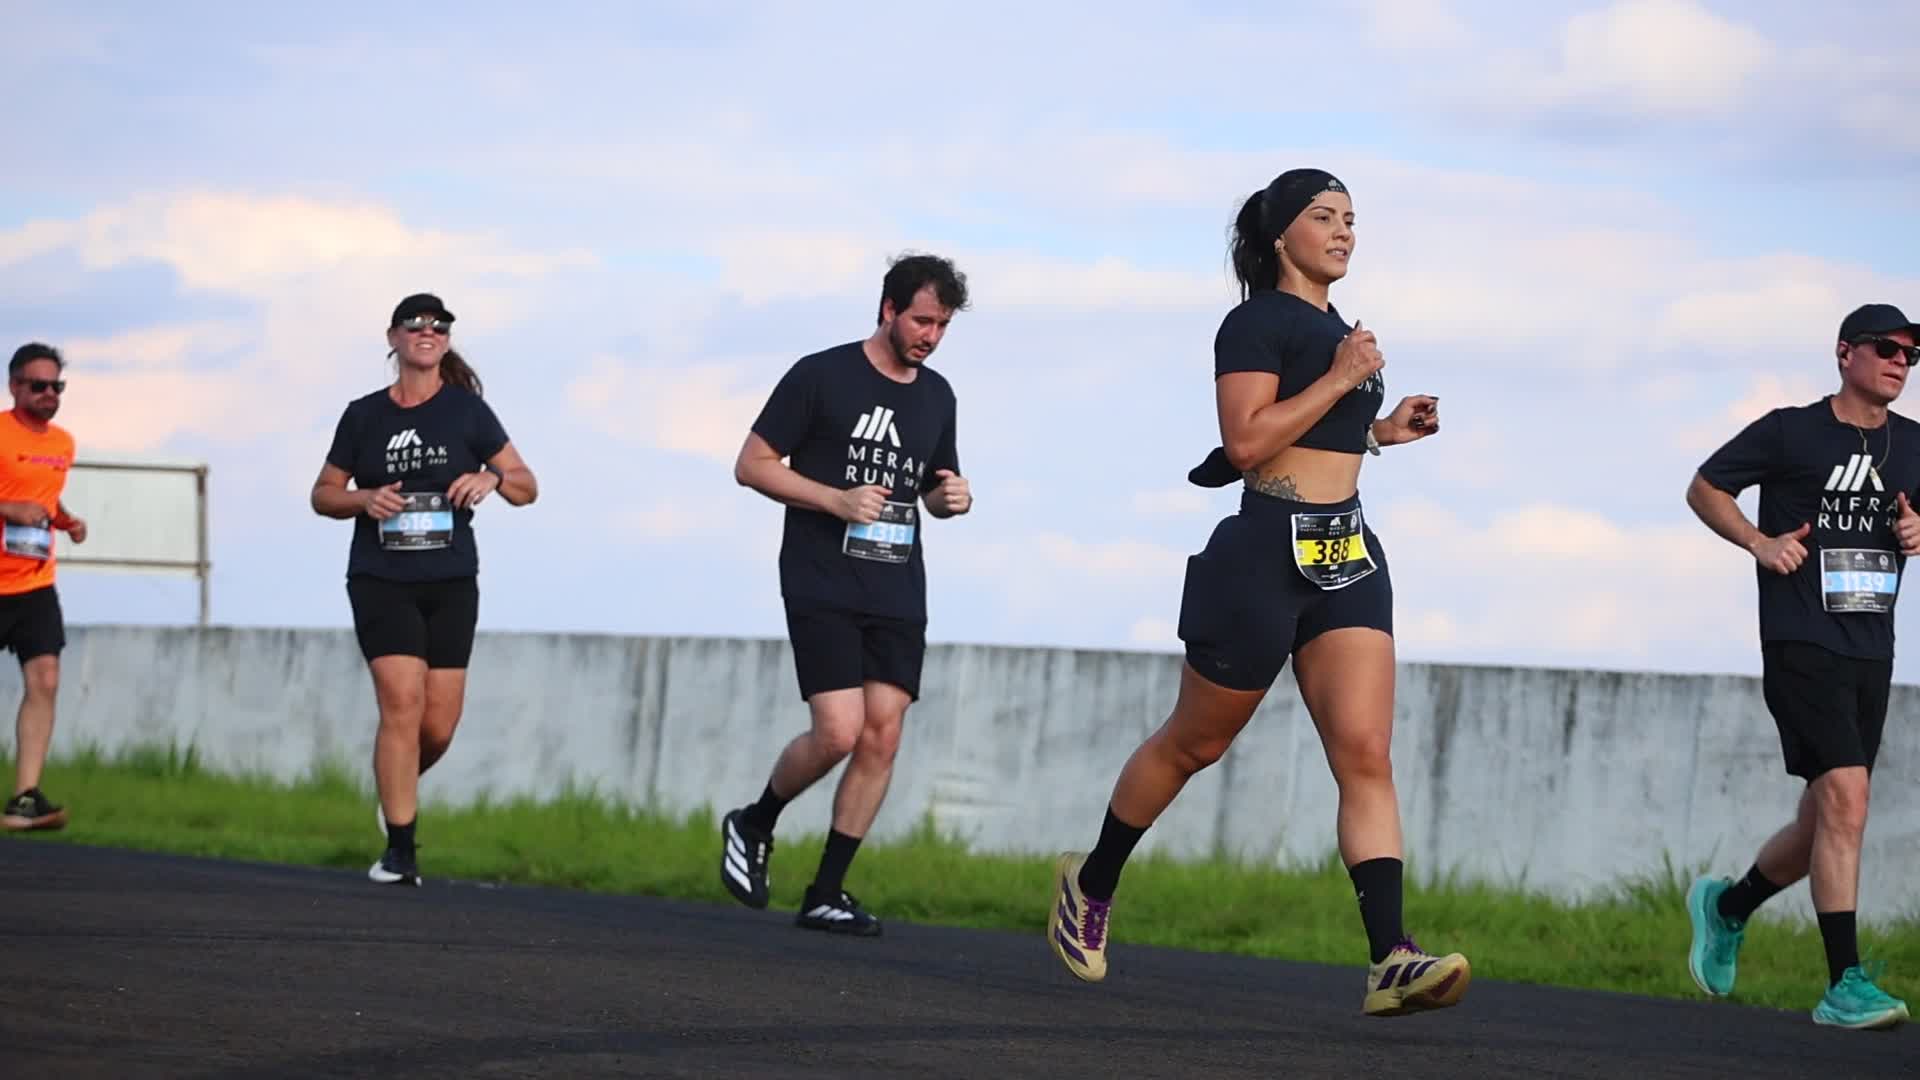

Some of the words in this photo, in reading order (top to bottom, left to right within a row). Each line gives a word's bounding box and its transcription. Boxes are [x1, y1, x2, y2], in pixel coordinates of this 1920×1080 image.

[384, 447, 447, 461] MERAK
[387, 460, 421, 473] RUN
[845, 464, 895, 488] RUN
[398, 513, 432, 531] 616
[1817, 513, 1874, 532] RUN
[1313, 538, 1350, 564] 388
[1841, 571, 1885, 593] 1139
